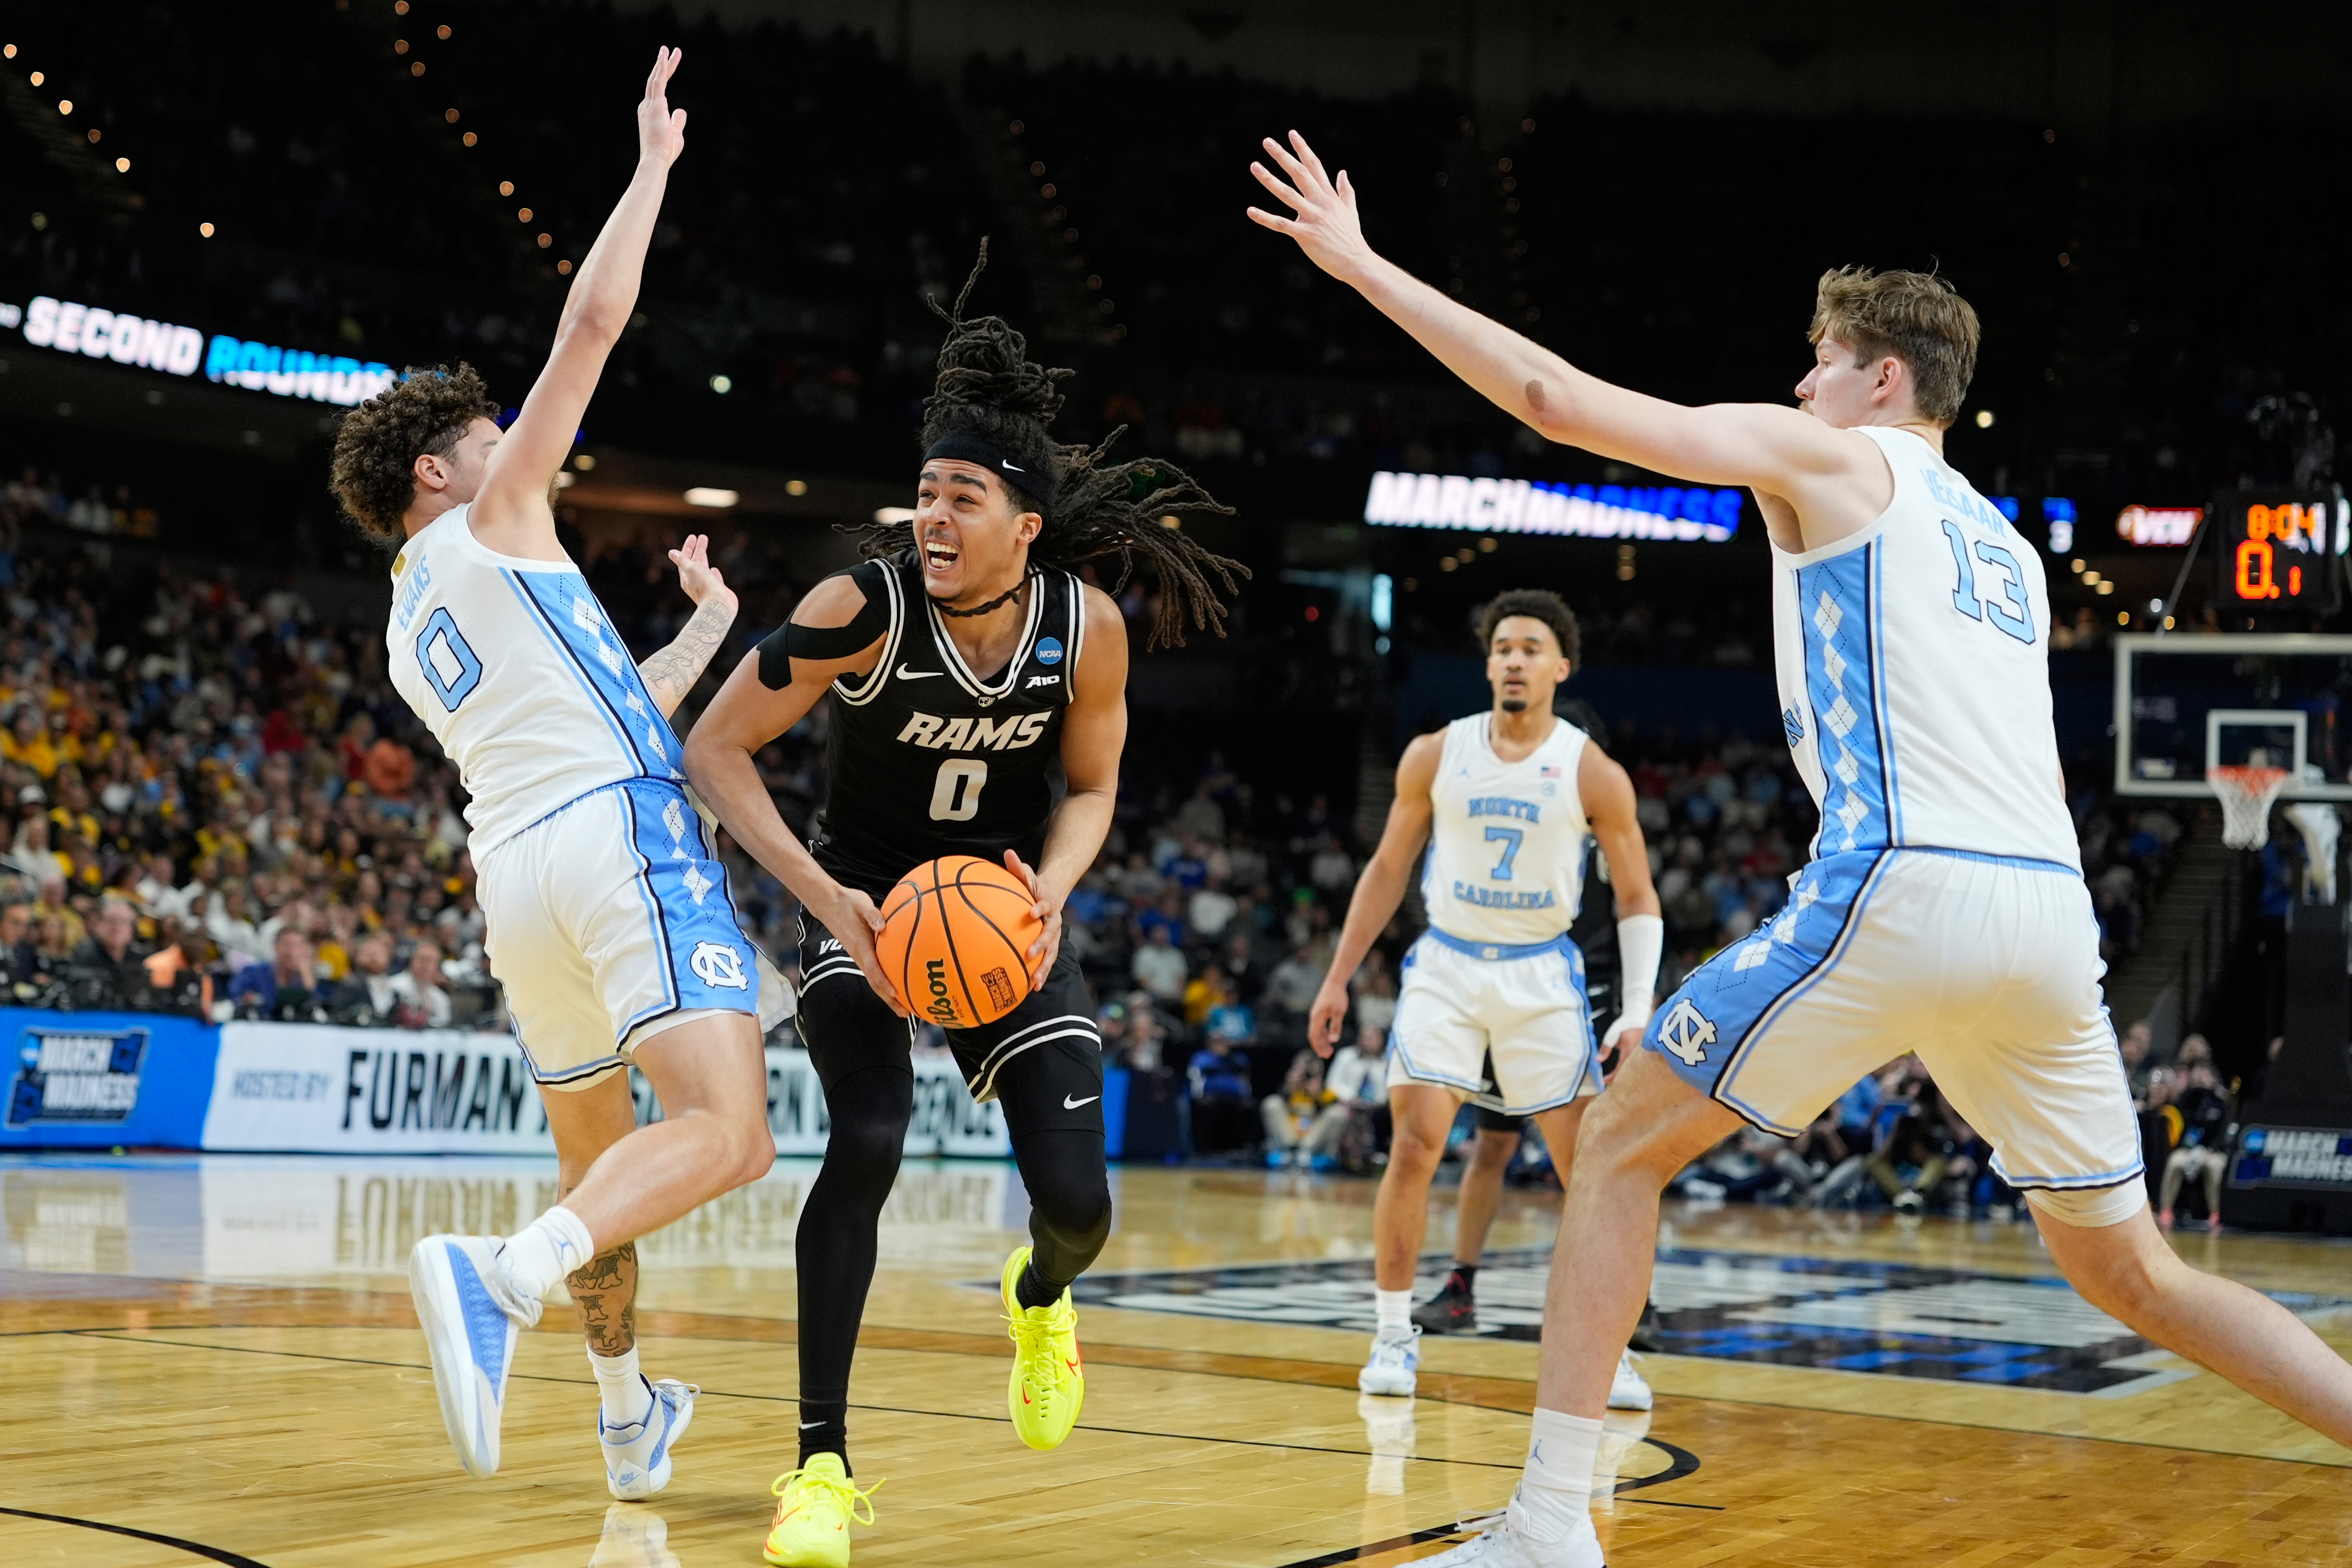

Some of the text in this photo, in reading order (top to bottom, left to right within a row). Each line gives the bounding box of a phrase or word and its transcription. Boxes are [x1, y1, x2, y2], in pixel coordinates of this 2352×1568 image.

[23, 296, 204, 377] SECOND
[396, 554, 431, 631] EVANS
[1941, 519, 2036, 645] 13
[416, 606, 483, 713] 0
[1025, 675, 1060, 688] A10
[896, 710, 1052, 751] RAMS
[929, 758, 987, 821] 0
[1469, 797, 1541, 824] NORTH
[1485, 826, 1523, 881] 7
[1453, 881, 1556, 910] CAROLINA
[819, 938, 846, 955] VC
[38, 1037, 113, 1072] MARCH
[43, 1074, 138, 1110] MADNESS
[342, 1051, 525, 1131] FURMAN
[2264, 1131, 2339, 1154] MARCH
[2271, 1154, 2352, 1180] MADNES
